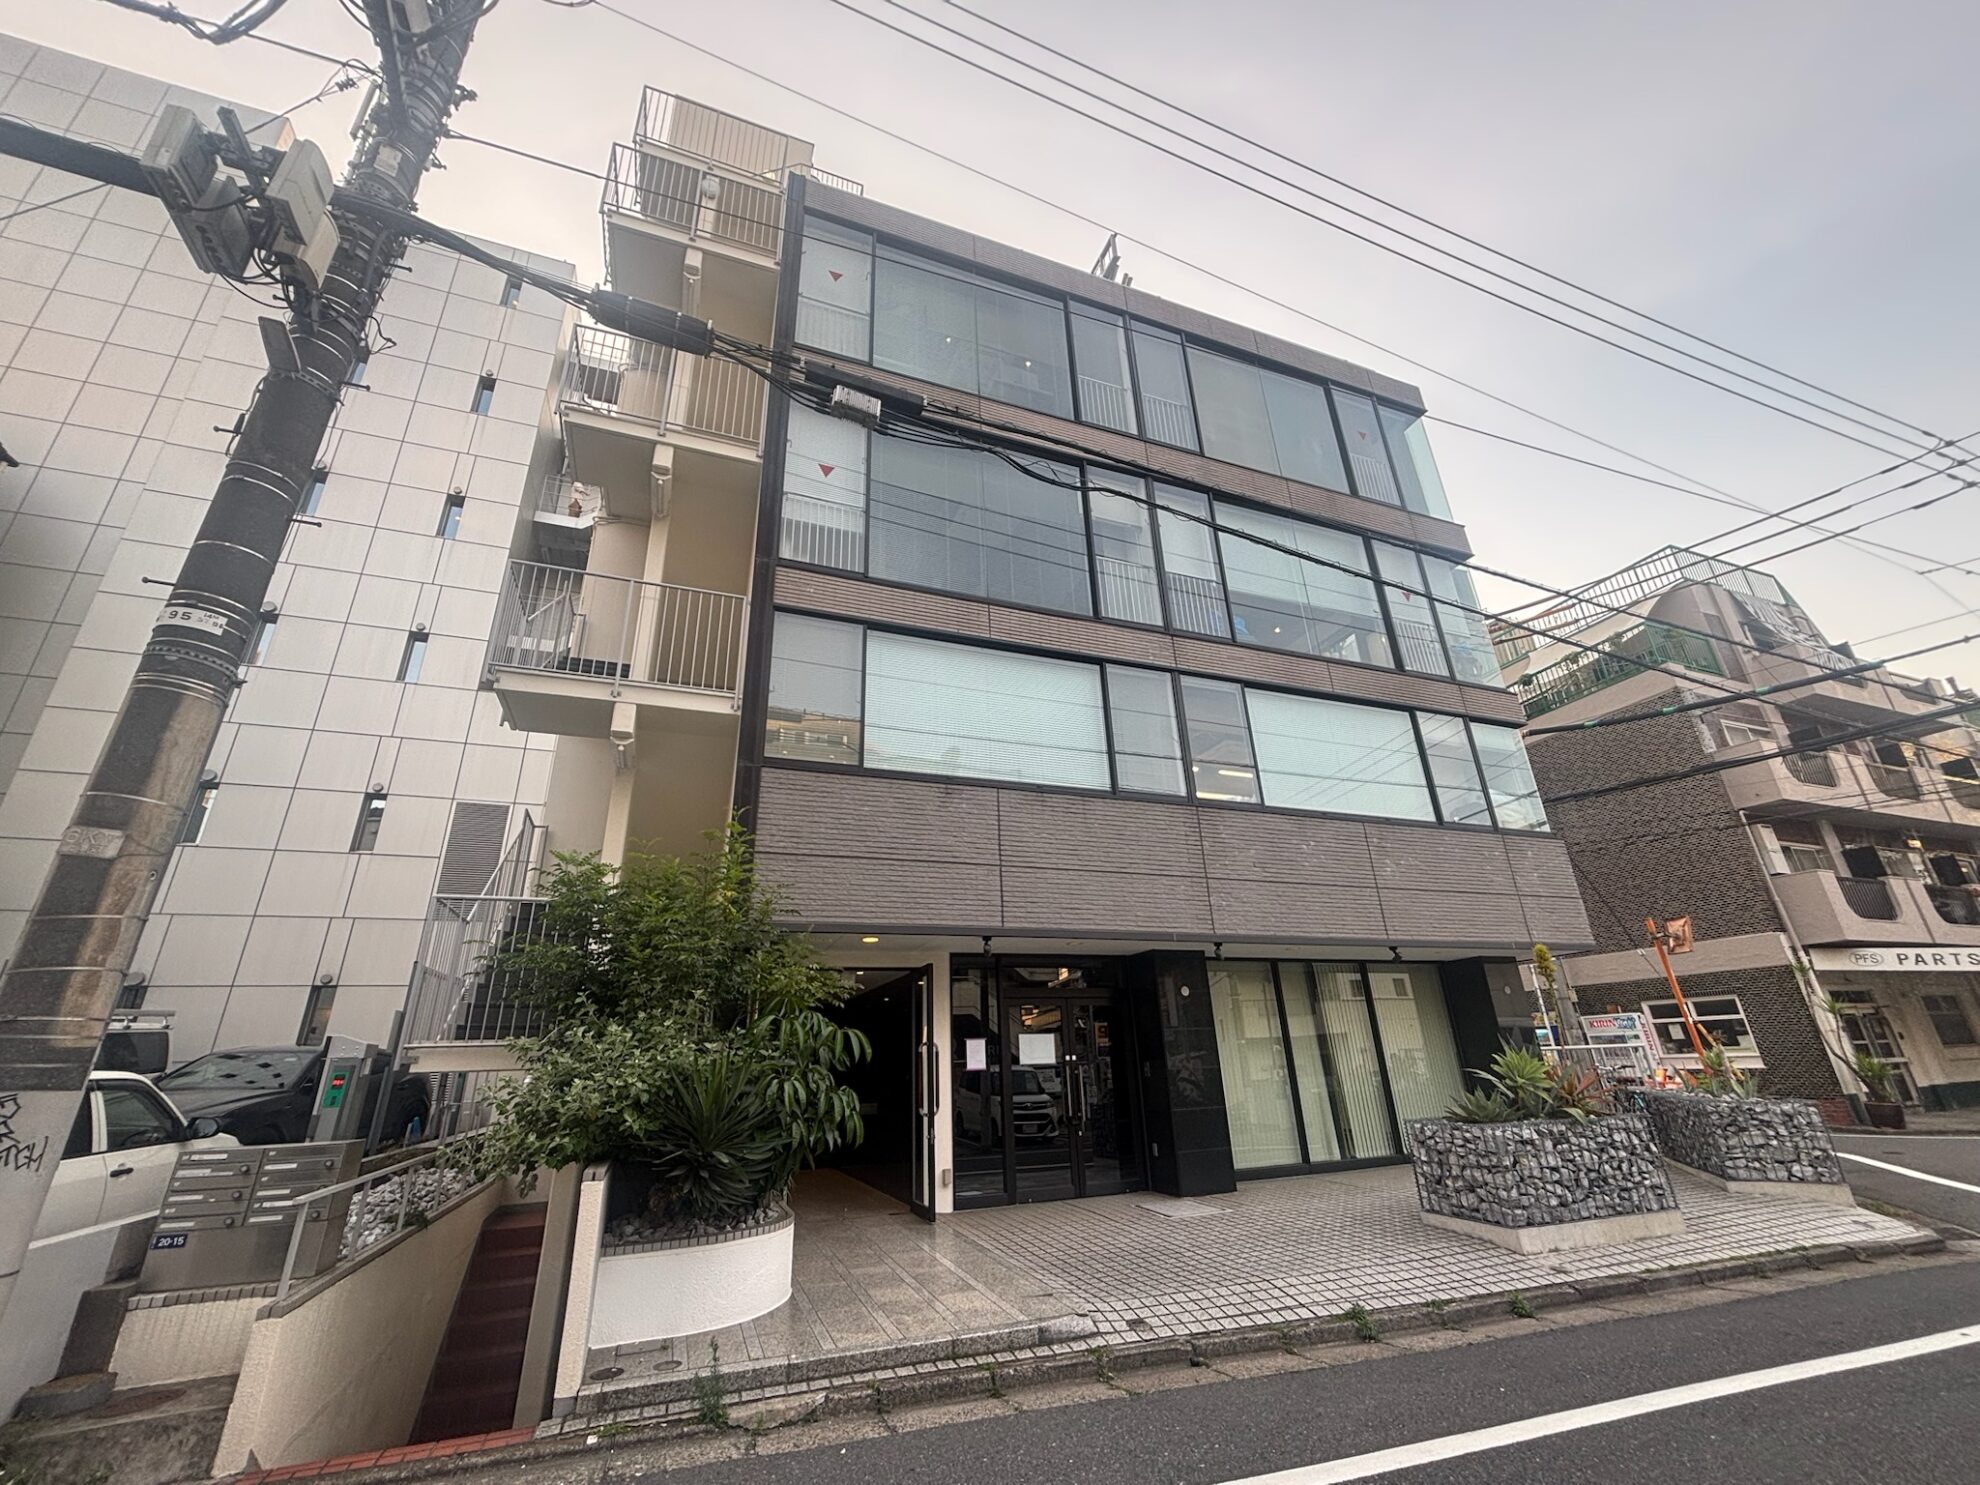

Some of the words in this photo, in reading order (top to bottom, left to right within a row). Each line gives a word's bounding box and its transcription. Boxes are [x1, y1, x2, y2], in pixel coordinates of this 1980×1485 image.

[1854, 953, 1880, 964] PFS
[1896, 952, 1980, 966] PARTS
[1588, 1018, 1617, 1029] KIRIN
[158, 1236, 185, 1247] 20-15
